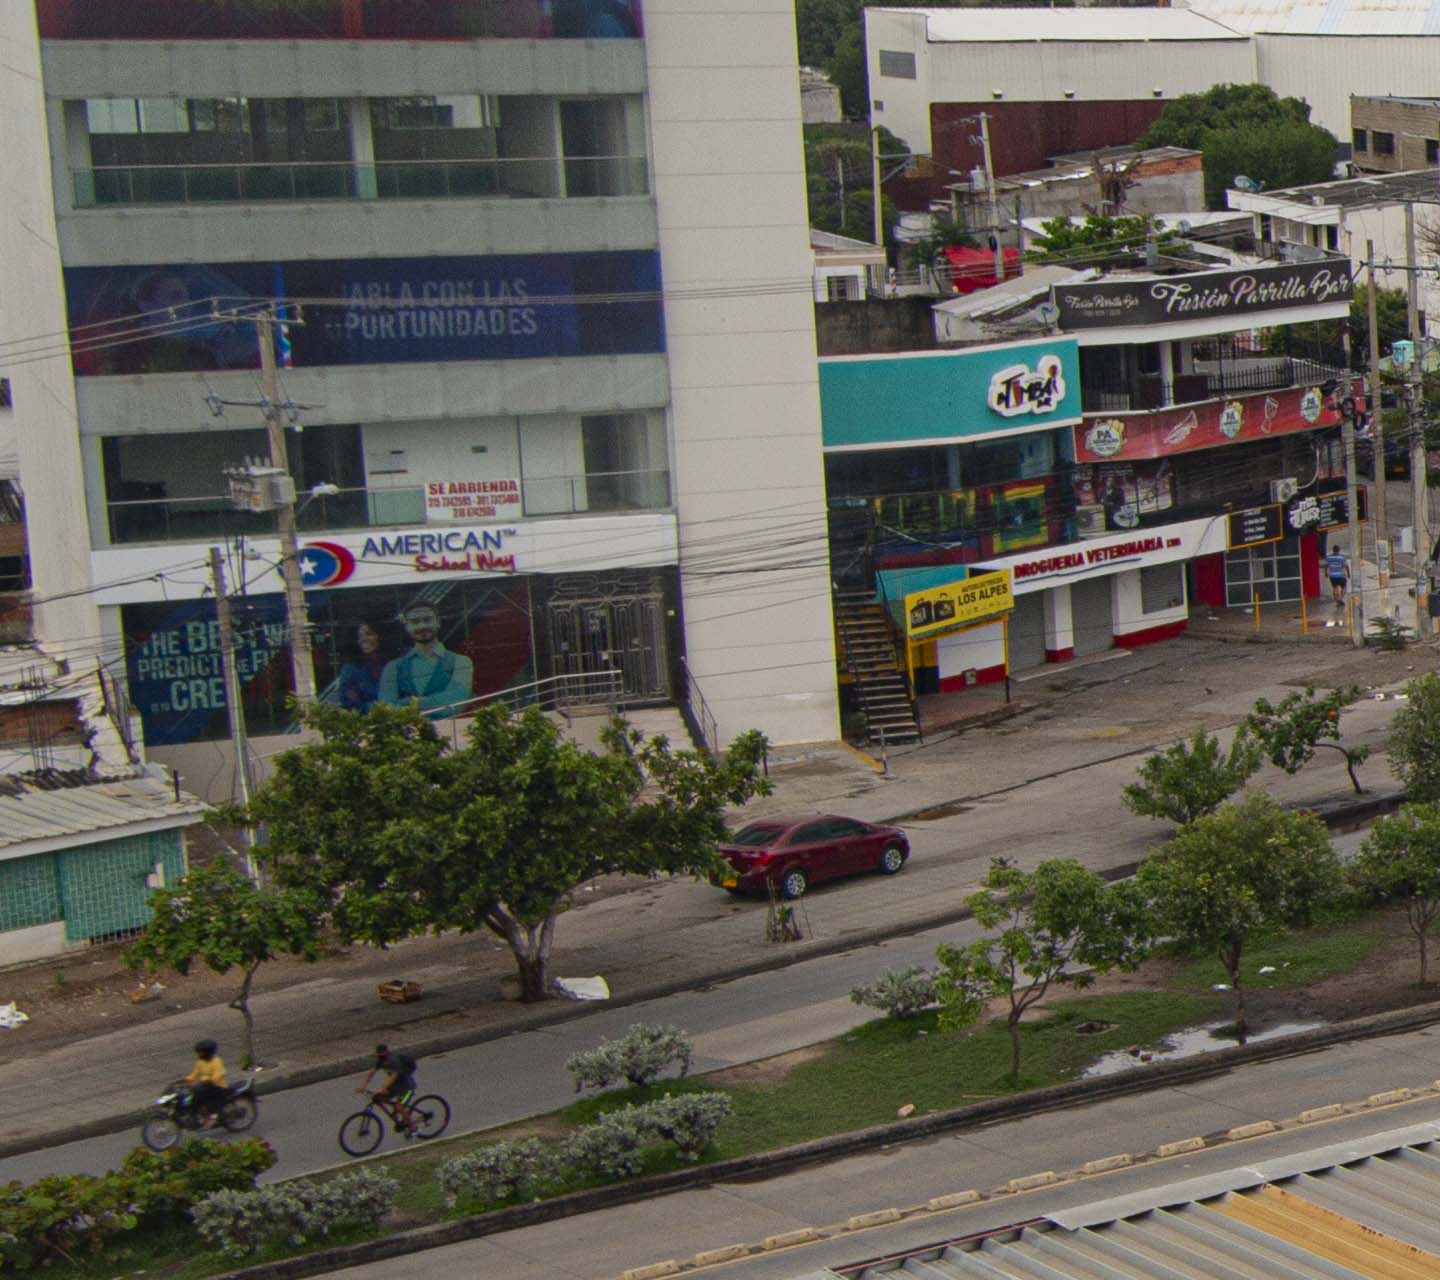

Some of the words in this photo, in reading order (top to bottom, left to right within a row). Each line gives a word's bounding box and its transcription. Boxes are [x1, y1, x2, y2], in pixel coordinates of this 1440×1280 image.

[1151, 281, 1230, 313] Fusión
[1230, 275, 1309, 305] Parrilla
[1309, 269, 1349, 300] Bar
[429, 482, 445, 495] SE
[449, 480, 517, 494] ARRIENDA
[415, 552, 470, 573] School
[476, 550, 515, 575] Way
[1015, 554, 1084, 580] DROGUERIA
[1086, 536, 1164, 566] VETERINARIA
[958, 590, 976, 606] LOS
[978, 583, 1008, 601] ALPES
